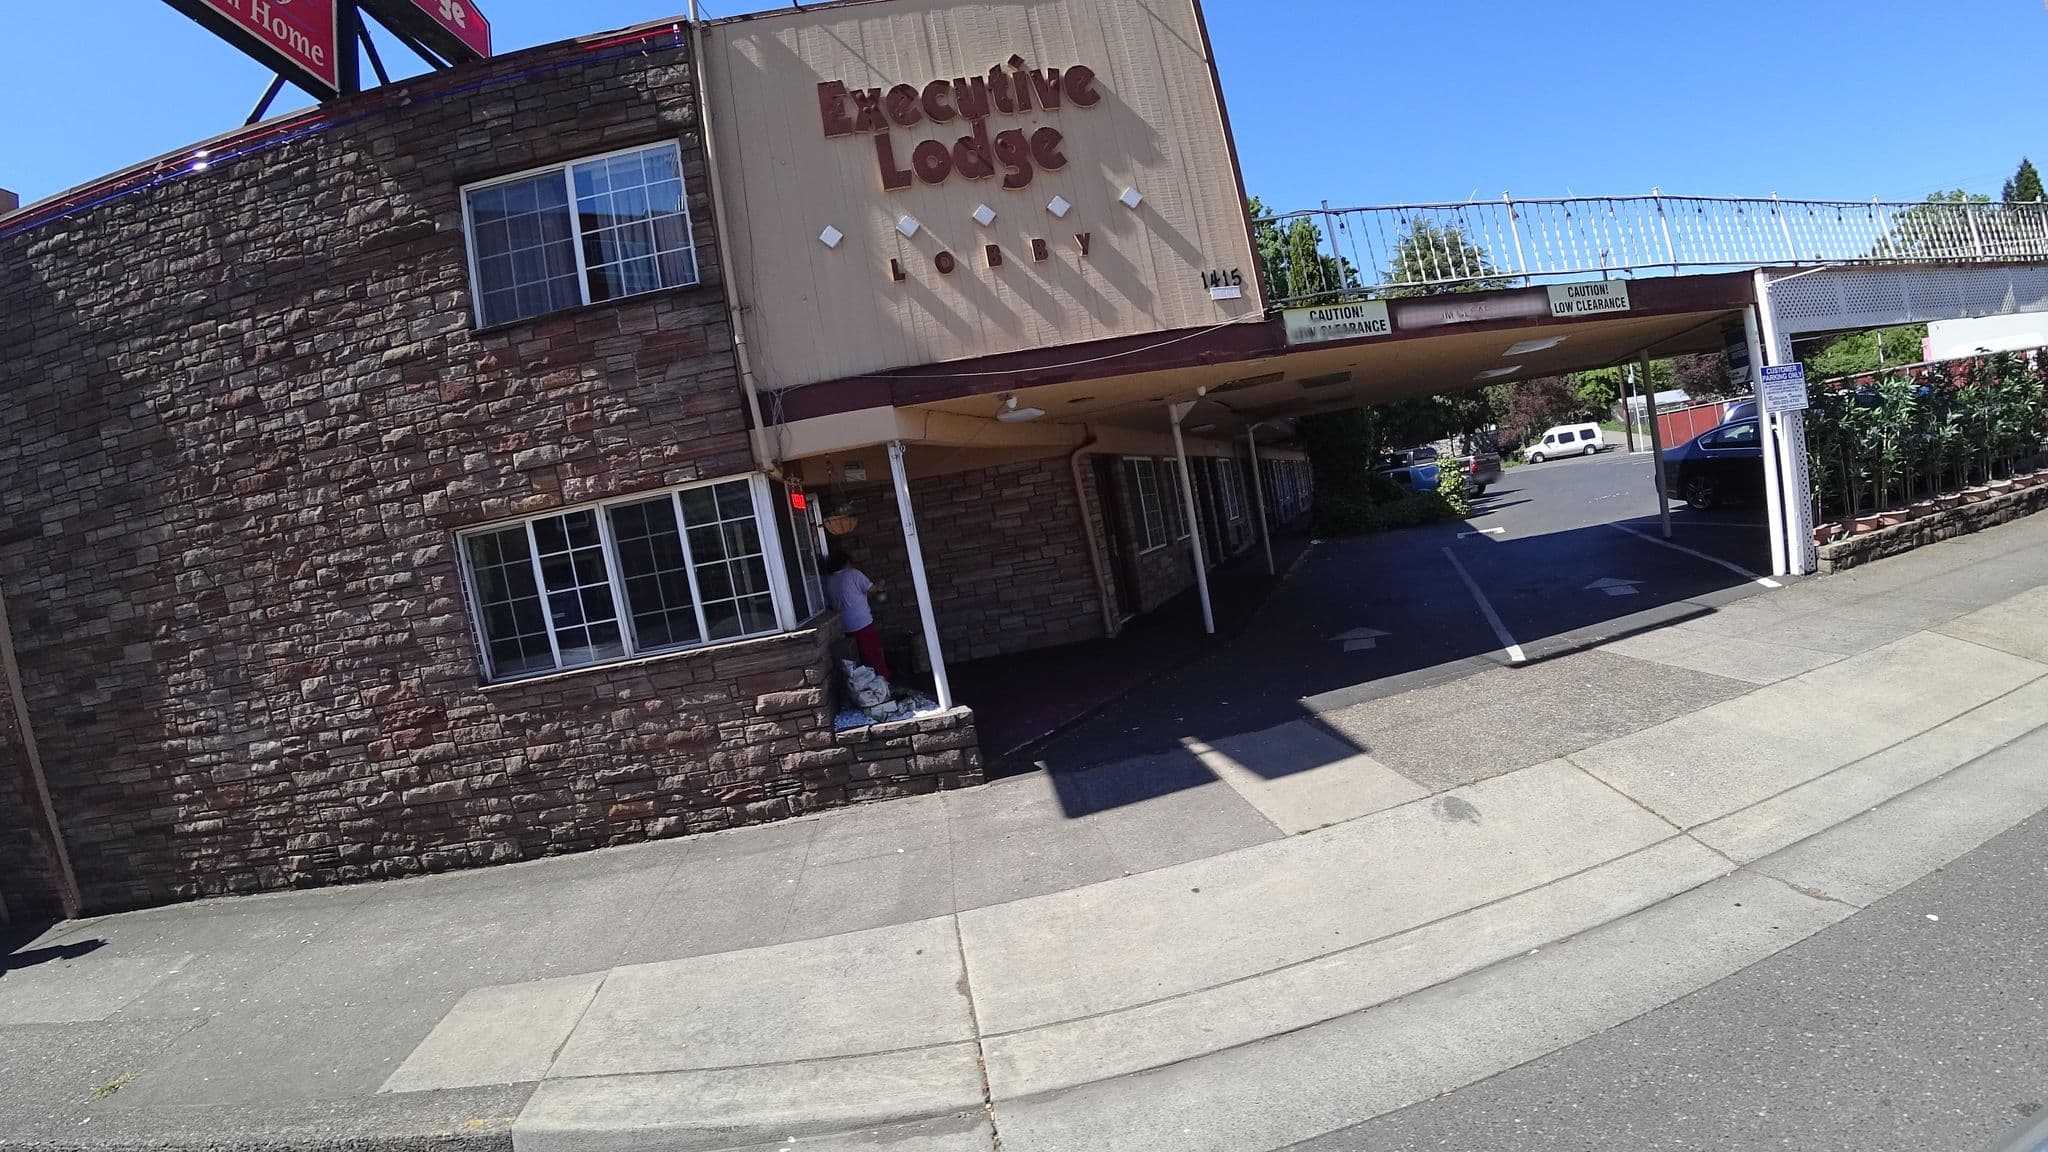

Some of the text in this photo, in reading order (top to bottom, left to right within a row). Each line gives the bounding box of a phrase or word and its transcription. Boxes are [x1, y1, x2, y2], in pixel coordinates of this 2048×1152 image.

[250, 0, 324, 66] Home
[817, 53, 1101, 137] Executive
[874, 118, 1068, 191] Lodge
[891, 232, 1090, 282] LOBBY
[1201, 268, 1242, 289] 1415
[1567, 283, 1609, 298] CAUTION!
[1309, 305, 1364, 321] CAUTION!
[1554, 296, 1627, 314] LOW CLEARANCE
[1762, 371, 1802, 382] PARKING ONLY
[1766, 365, 1797, 375] CUSTOMER
